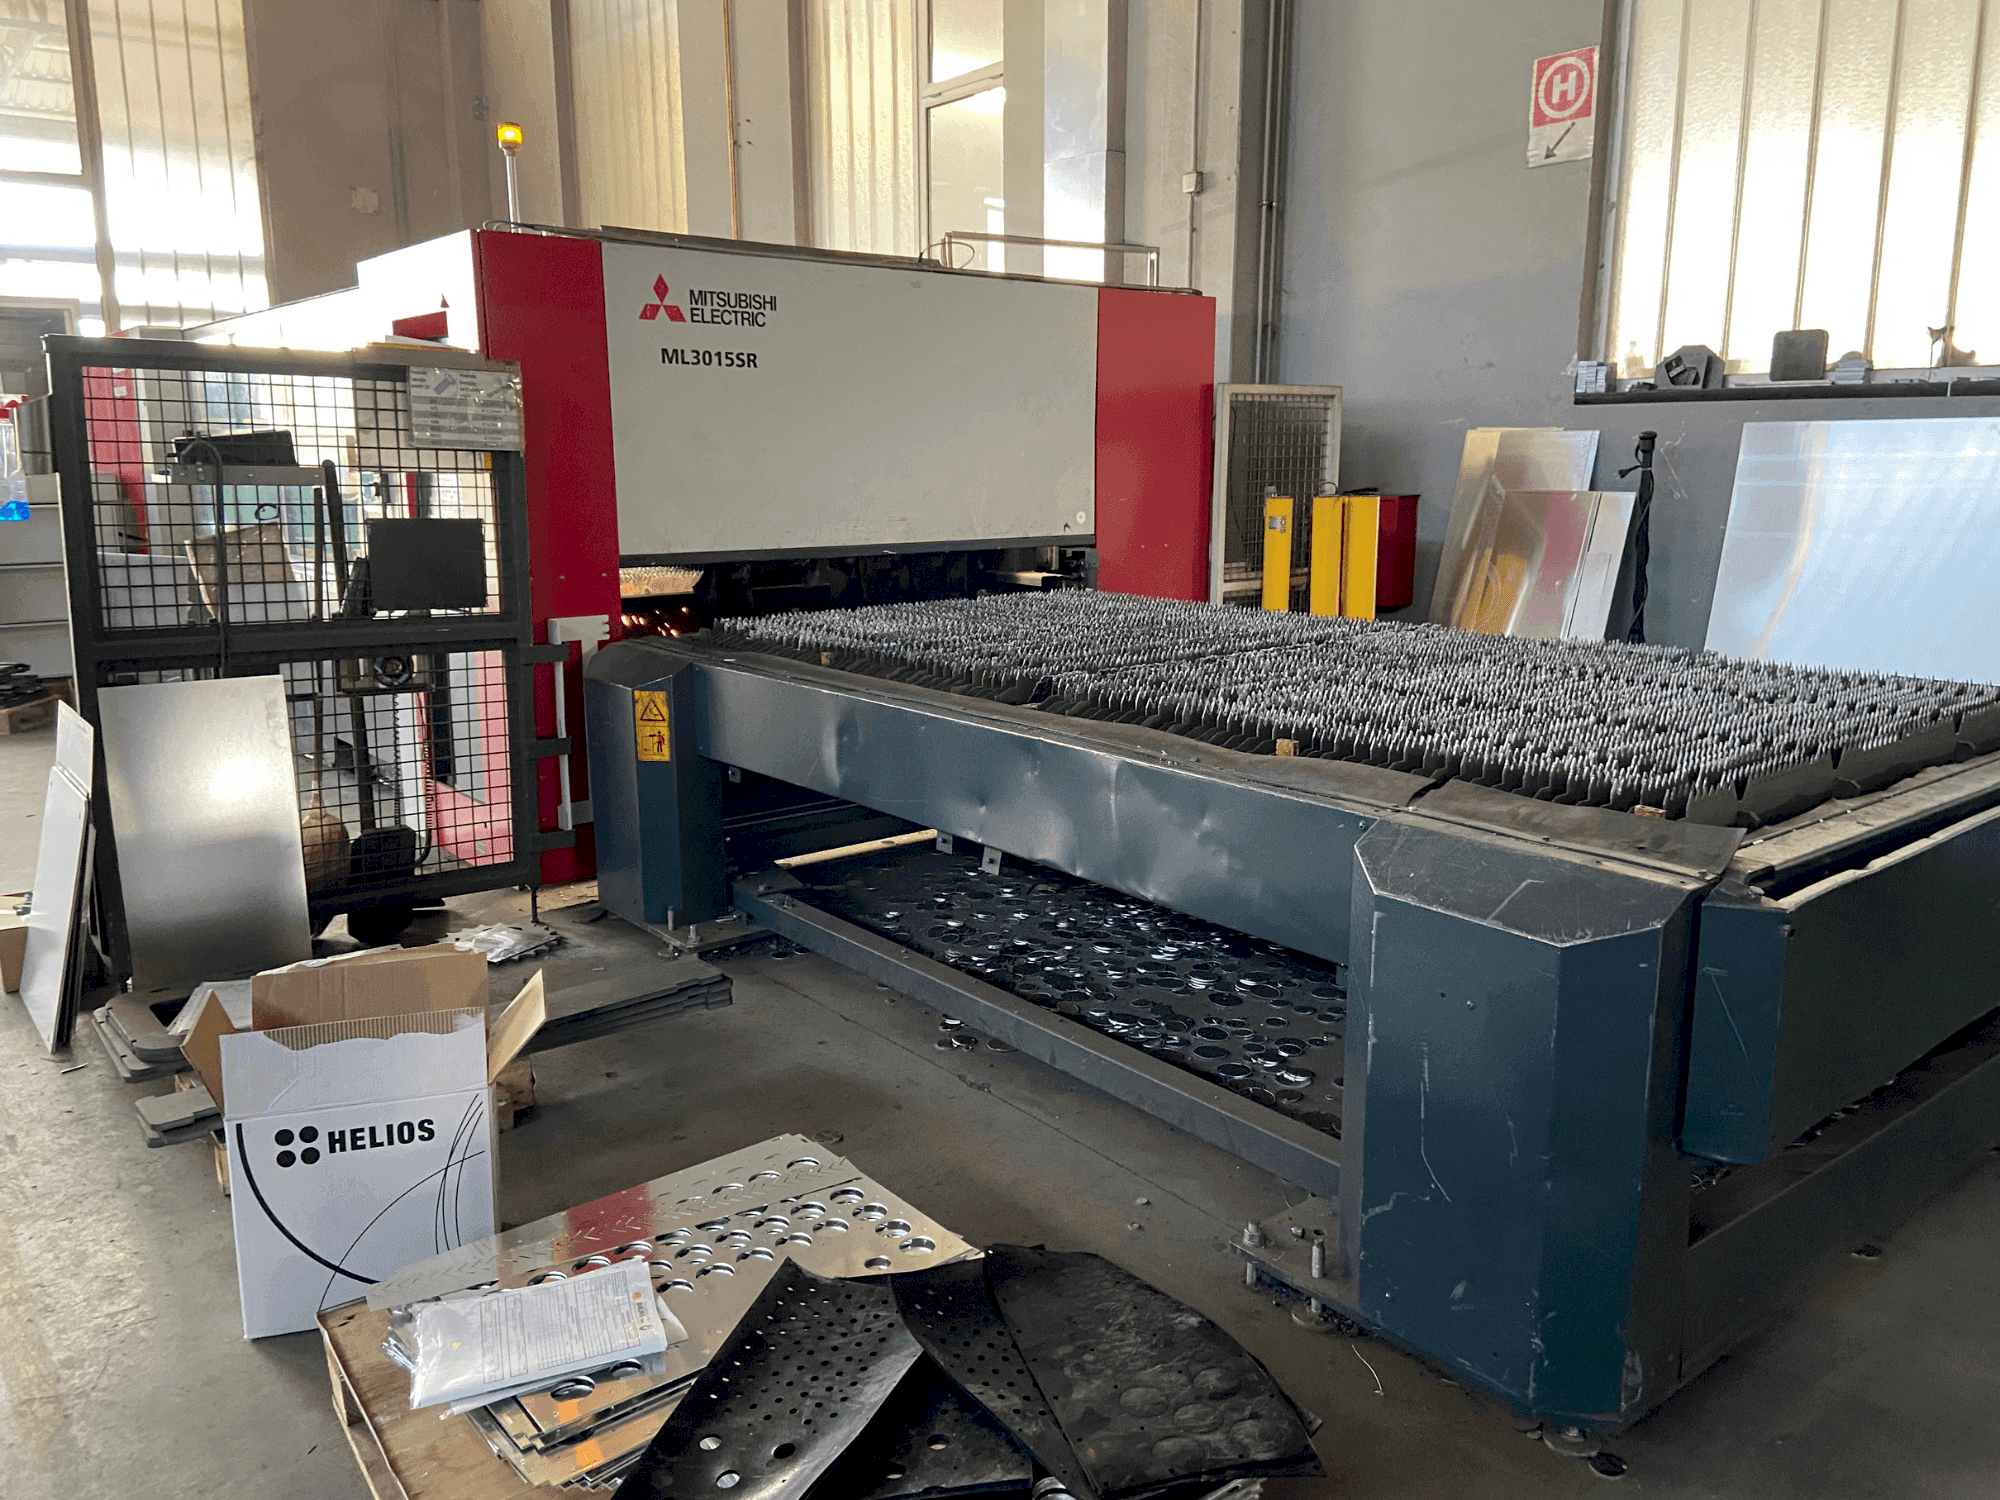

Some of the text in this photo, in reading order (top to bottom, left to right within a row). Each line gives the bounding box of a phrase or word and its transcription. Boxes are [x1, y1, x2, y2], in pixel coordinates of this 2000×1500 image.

[1552, 71, 1577, 104] H
[689, 289, 777, 311] MITSUBISHI
[690, 307, 766, 327] ELECTRIC
[661, 348, 758, 369] ML3015SR
[328, 1118, 435, 1154] HELIOS
